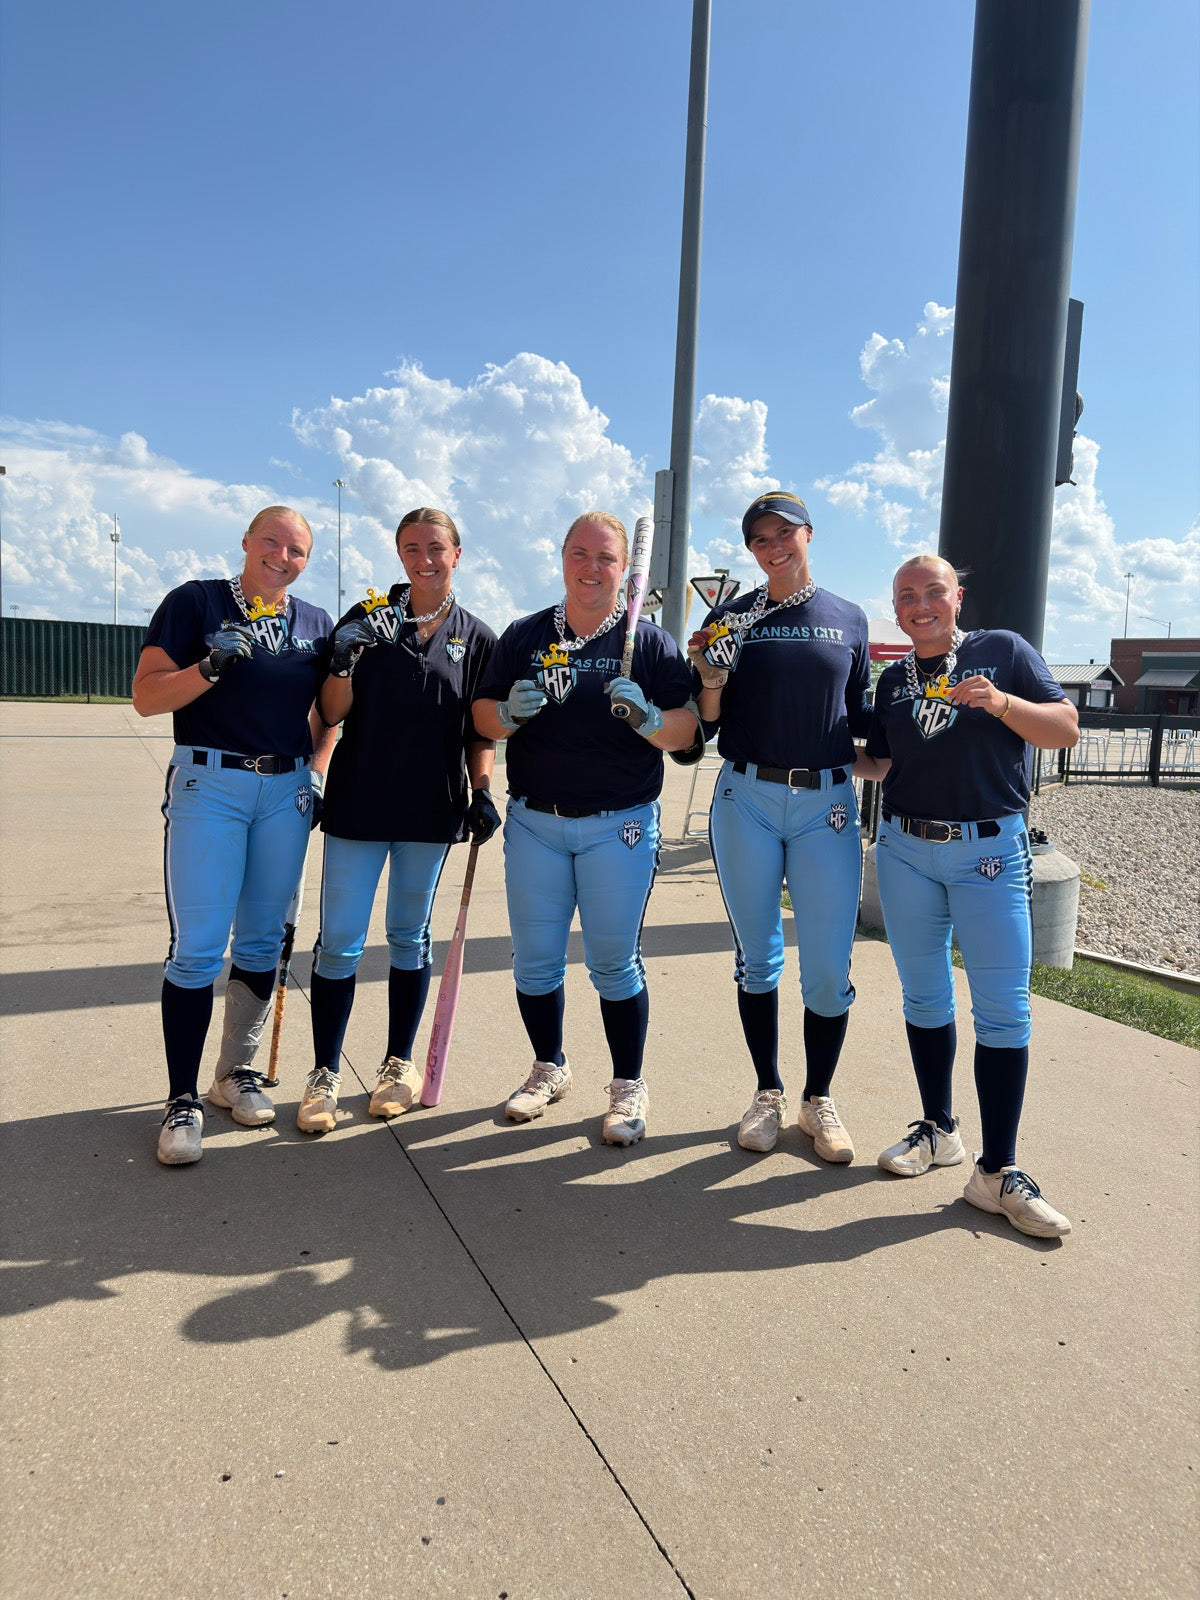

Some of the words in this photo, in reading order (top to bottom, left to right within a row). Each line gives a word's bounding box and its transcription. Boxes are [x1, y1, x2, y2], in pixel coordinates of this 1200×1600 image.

[251, 617, 283, 652] KC
[367, 606, 397, 640] KC
[750, 626, 810, 639] KANSAS
[814, 626, 843, 640] CITY
[708, 634, 736, 666] KC
[543, 666, 572, 700] KC
[918, 699, 951, 735] KC
